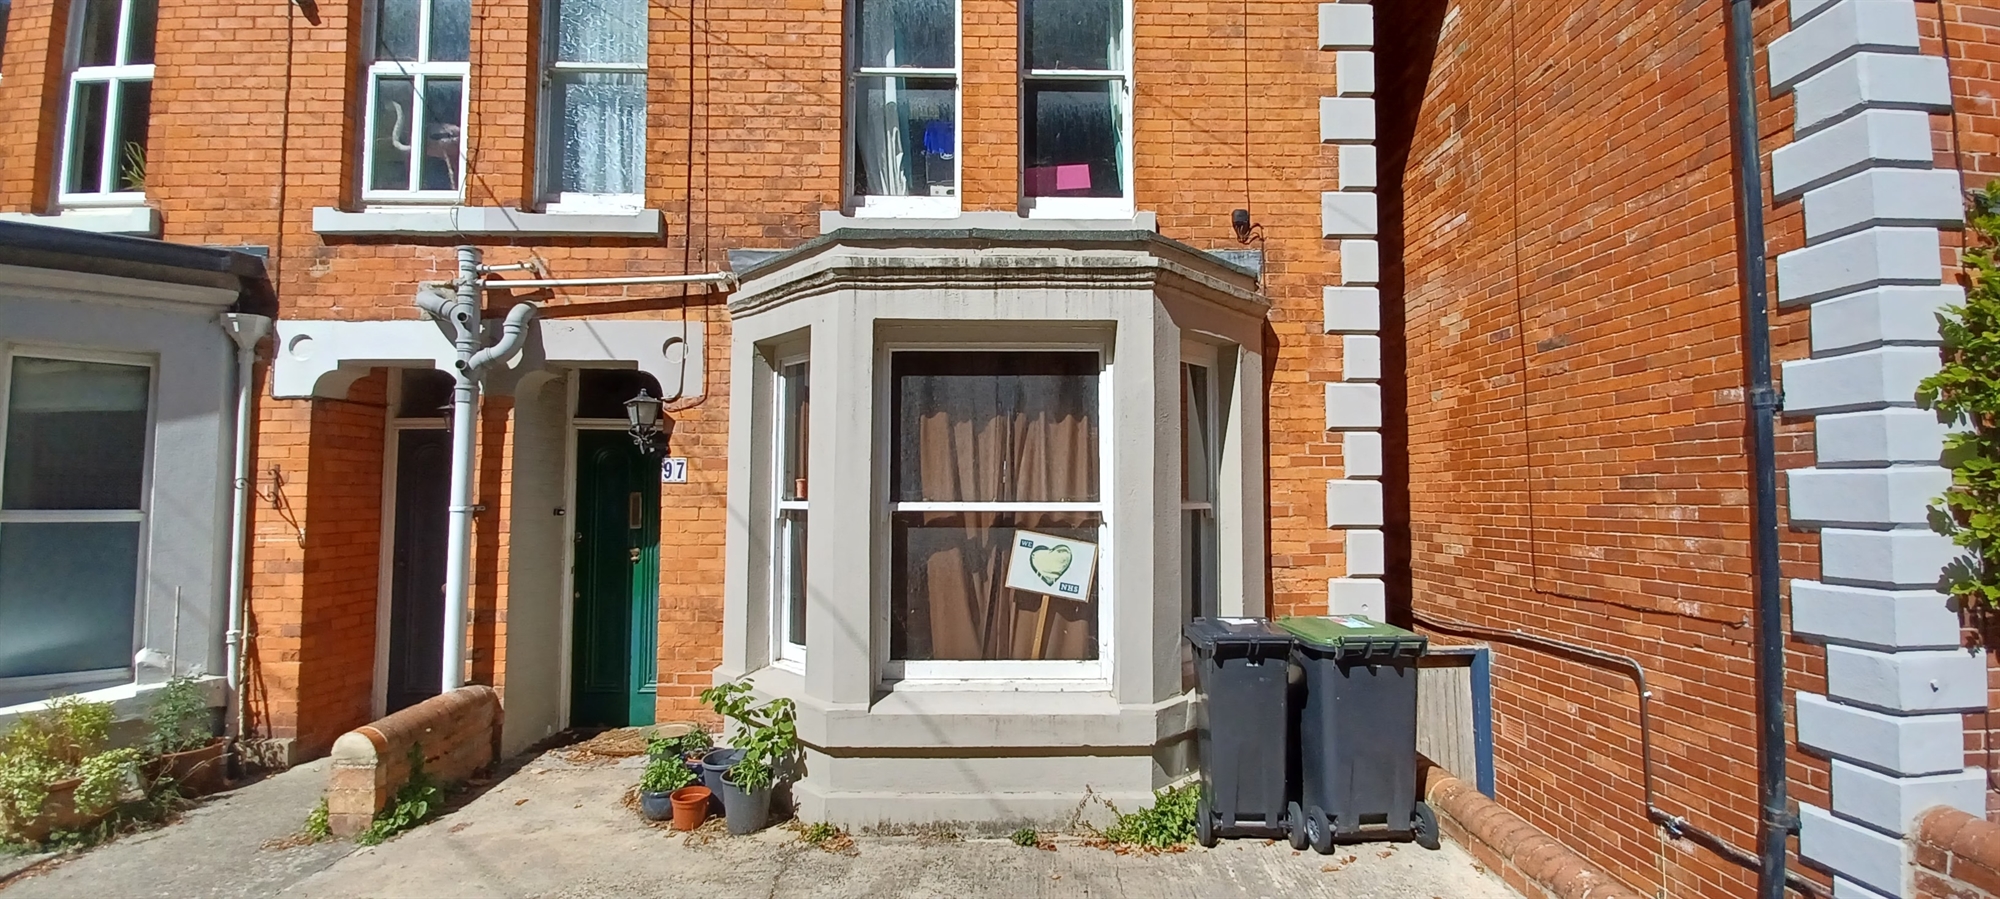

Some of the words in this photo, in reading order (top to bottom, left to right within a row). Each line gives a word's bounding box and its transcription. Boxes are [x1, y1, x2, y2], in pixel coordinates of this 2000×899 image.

[663, 461, 685, 479] 97
[1021, 539, 1033, 548] WE
[1060, 583, 1079, 593] NHS
